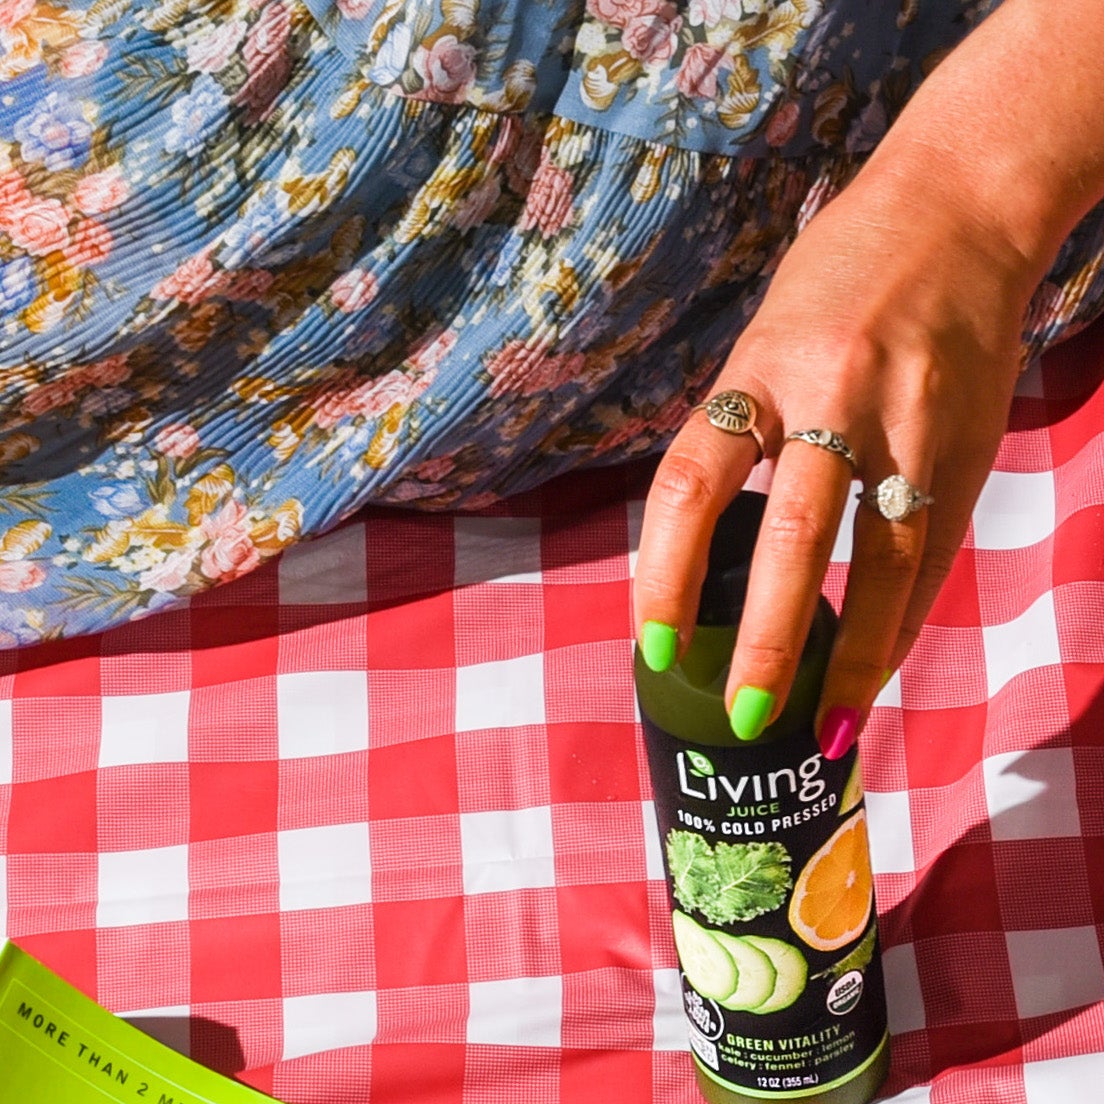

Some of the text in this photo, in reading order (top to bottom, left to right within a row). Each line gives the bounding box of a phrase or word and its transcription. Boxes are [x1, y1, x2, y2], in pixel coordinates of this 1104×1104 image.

[676, 752, 826, 804] Living
[677, 793, 837, 835] 100% COLD PRESSED
[726, 802, 780, 818] JUICE
[17, 1002, 70, 1047] MORE
[78, 1043, 129, 1085] THAN
[136, 1082, 149, 1097] 2
[718, 1042, 742, 1057] kale
[750, 1050, 813, 1062] cucumber
[821, 1031, 856, 1052] lemon
[726, 1024, 841, 1051] GREEN VITALITY
[721, 1053, 756, 1071] celery
[765, 1059, 806, 1071] fennel
[814, 1043, 855, 1065] parsley
[757, 1076, 768, 1087] 12
